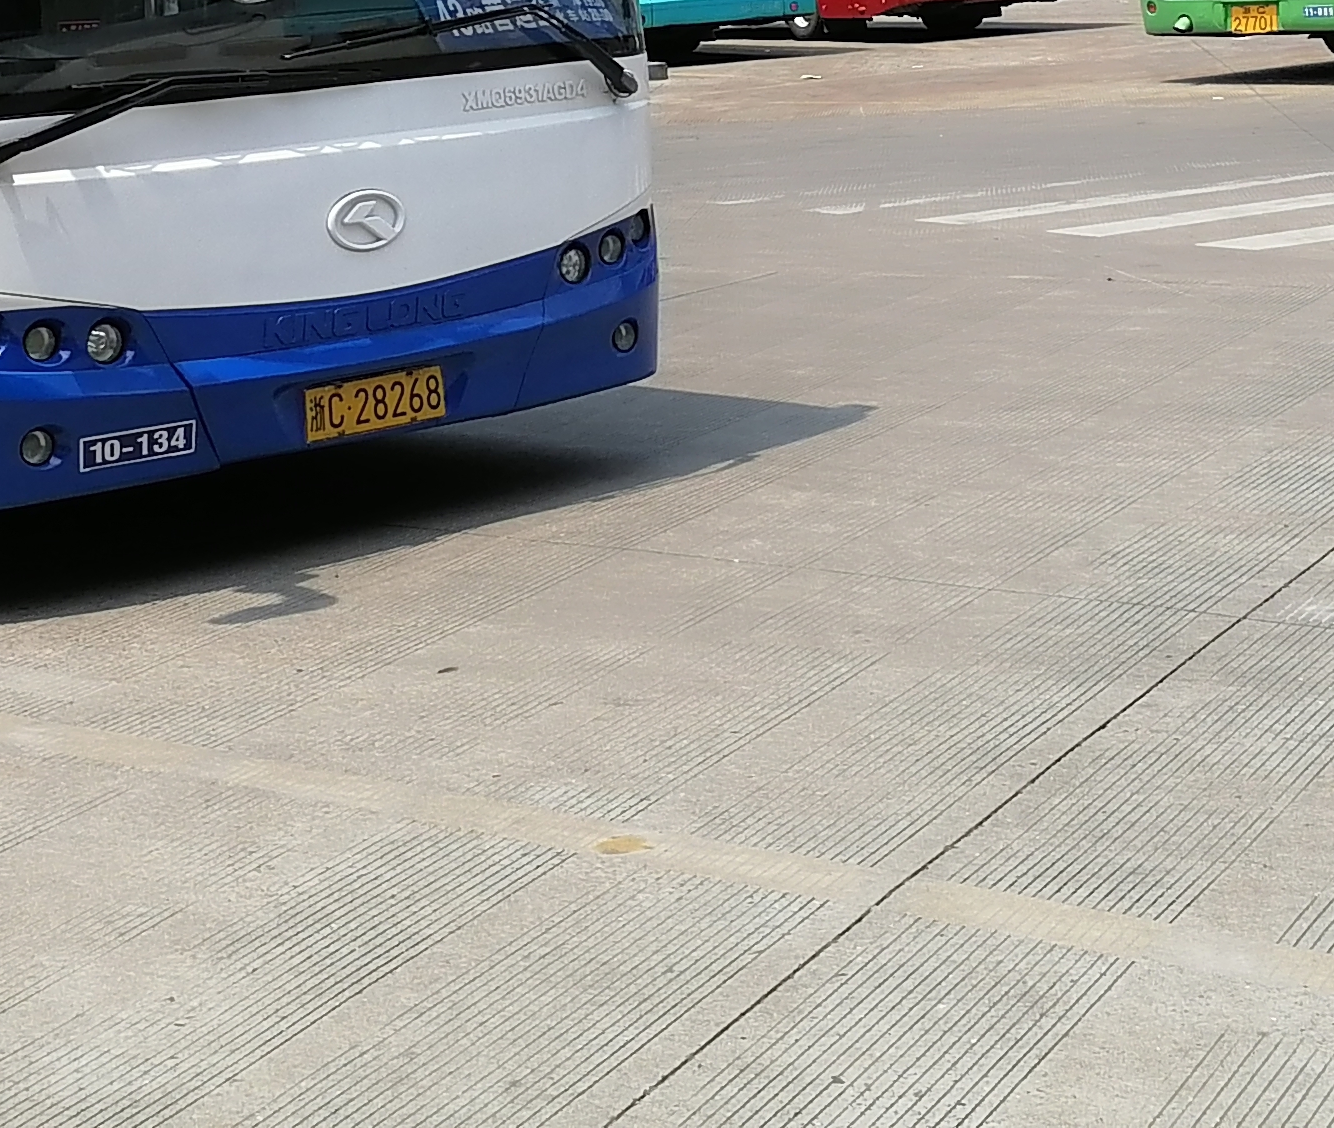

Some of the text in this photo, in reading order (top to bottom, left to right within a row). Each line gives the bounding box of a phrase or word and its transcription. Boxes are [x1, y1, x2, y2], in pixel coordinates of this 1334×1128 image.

[1233, 14, 1274, 32] 27701
[461, 78, 588, 113] XMQ6931AGD4
[262, 289, 467, 350] KING LONG
[89, 426, 187, 465] 10-134
